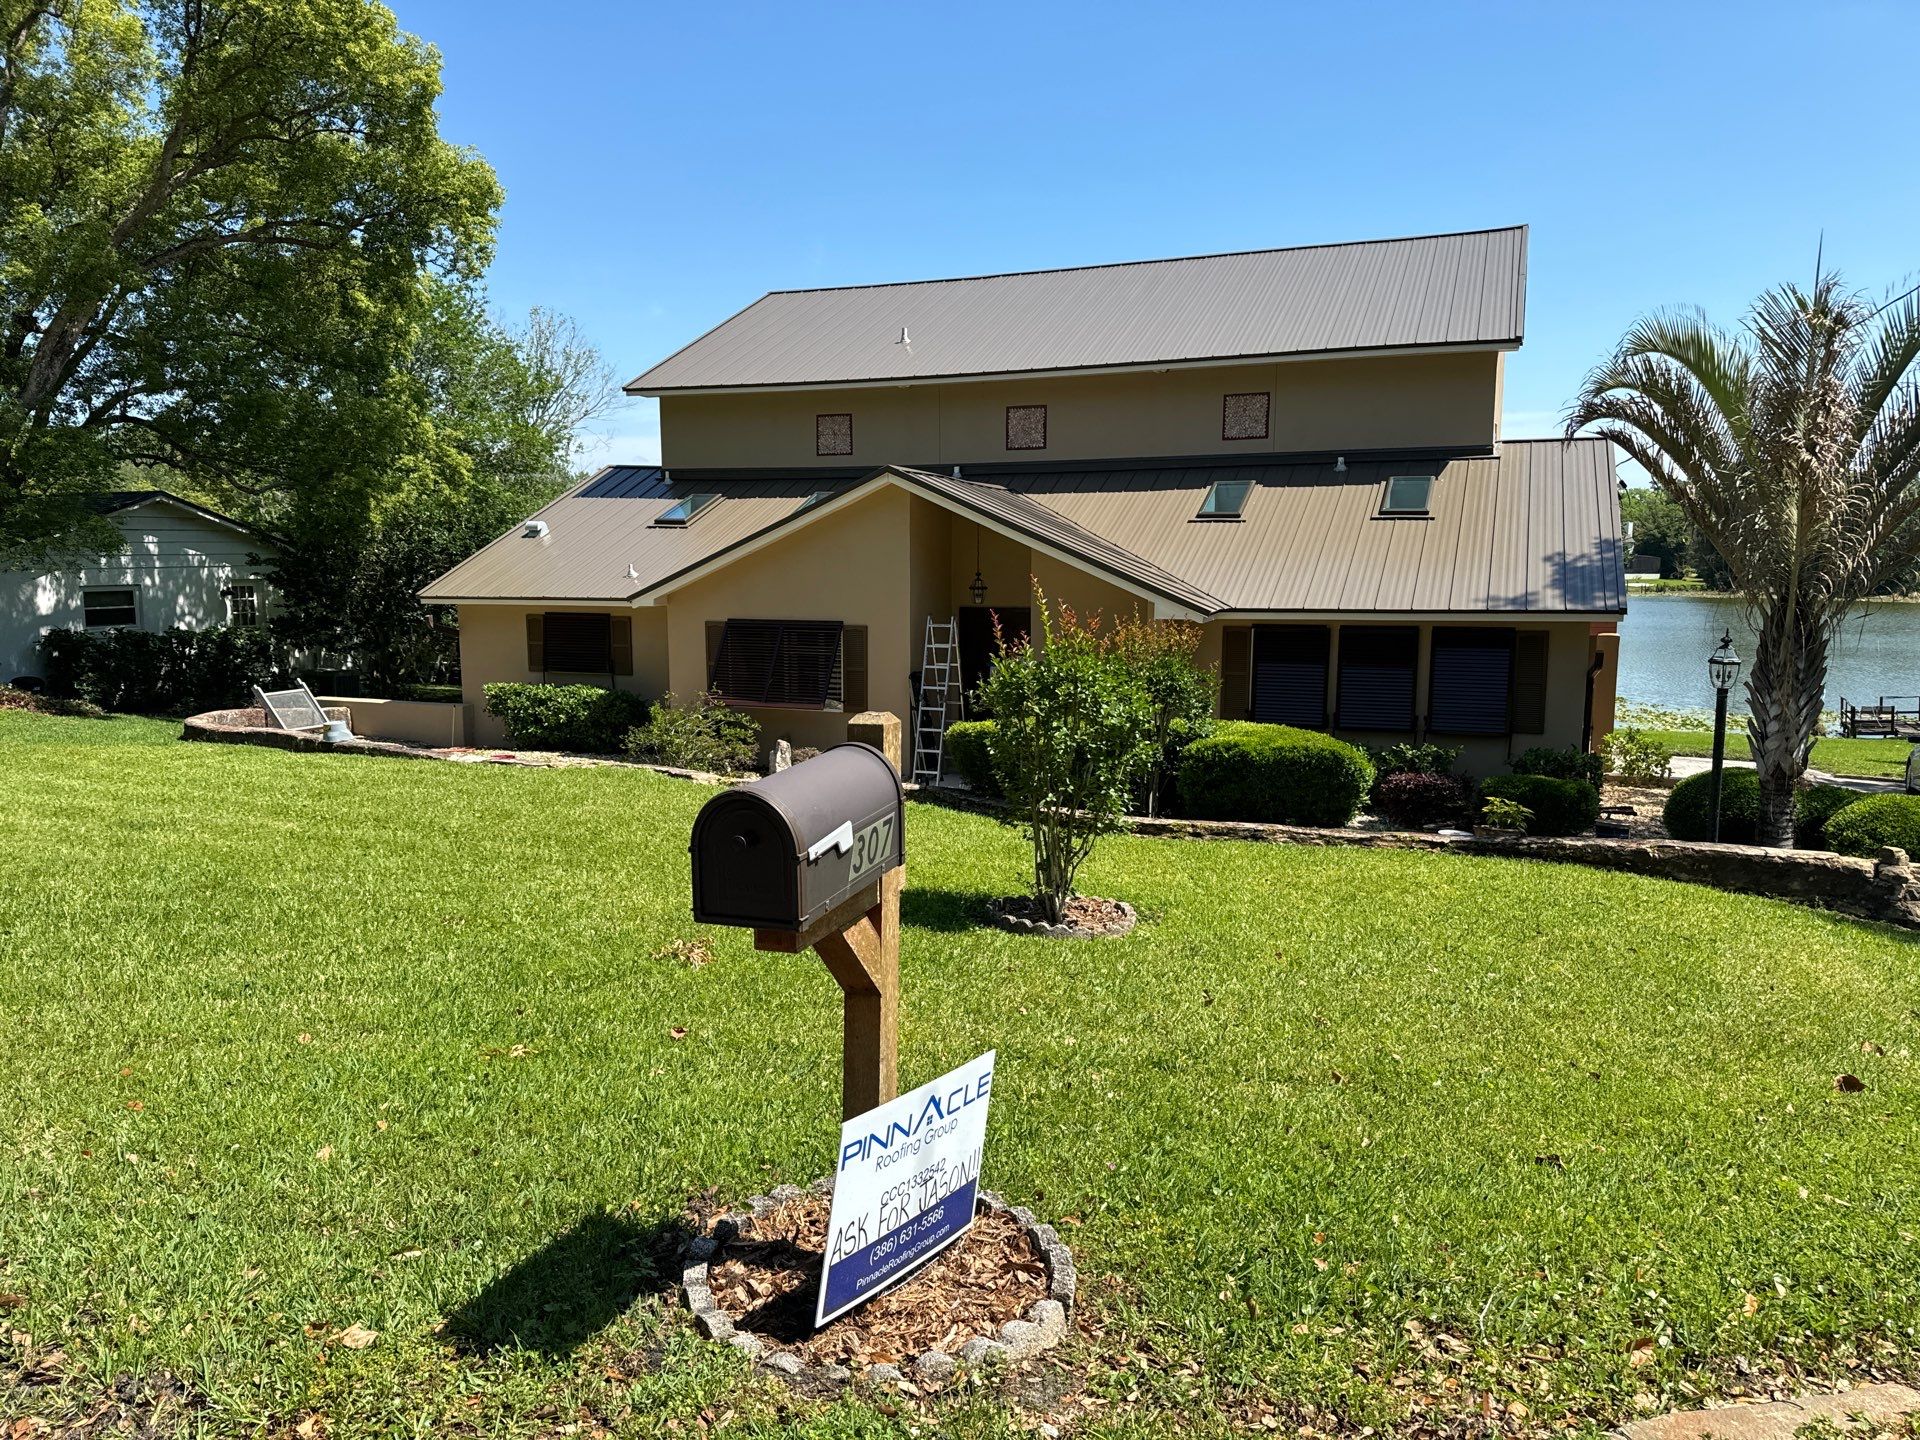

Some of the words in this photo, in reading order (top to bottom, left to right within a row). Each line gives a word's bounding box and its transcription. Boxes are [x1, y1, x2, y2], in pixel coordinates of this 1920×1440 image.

[852, 817, 894, 874] 307
[841, 1071, 991, 1171] PINNACLE
[875, 1138, 921, 1173] Roofing
[924, 1117, 959, 1146] Group
[829, 1212, 869, 1269] ASK
[878, 1193, 911, 1238] FOR
[856, 1223, 950, 1290] PinnacleRoofingGroup.com
[869, 1234, 898, 1266] (386)
[899, 1205, 945, 1242] 631-5566
